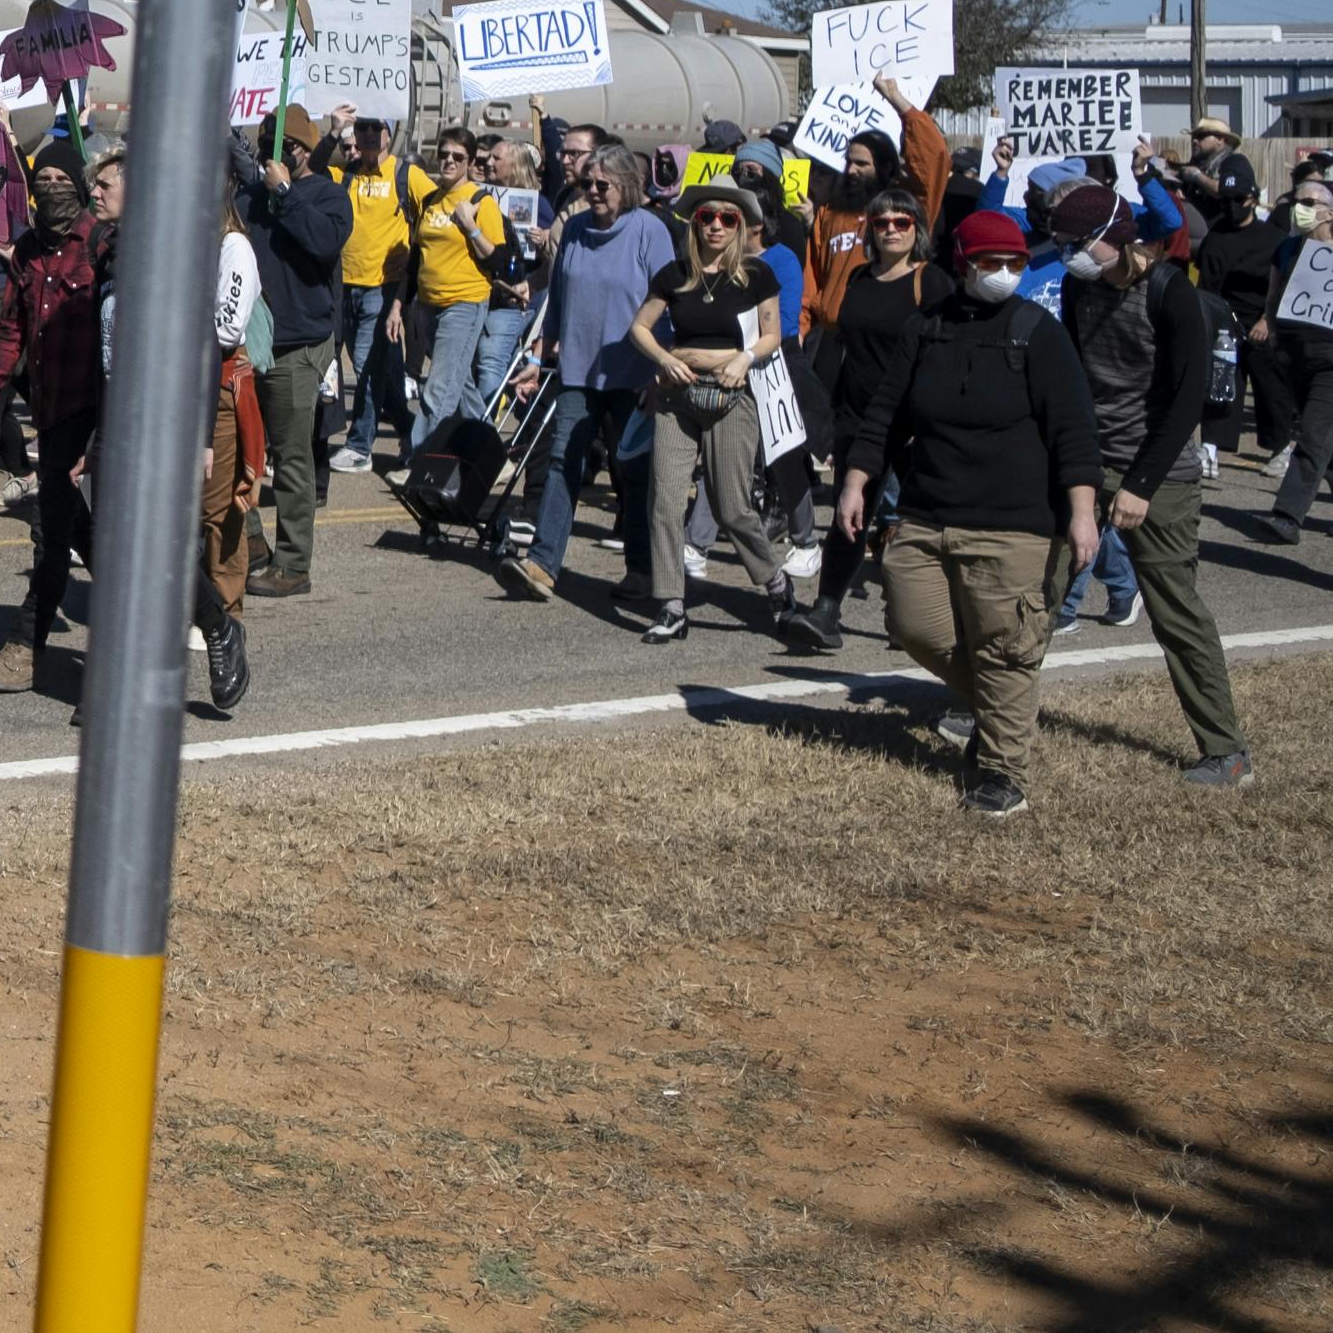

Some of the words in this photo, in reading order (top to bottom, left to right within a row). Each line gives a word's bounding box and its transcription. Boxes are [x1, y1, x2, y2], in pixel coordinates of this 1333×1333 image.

[15, 22, 93, 59] FAMILIA
[312, 30, 408, 57] TRUMP'S
[459, 1, 601, 62] LIBERTAD!
[826, 3, 929, 48] FUCK
[236, 39, 269, 63] WE
[853, 36, 921, 76] ICE
[307, 64, 408, 91] GESTAPO
[1008, 72, 1132, 103] REMEMBER
[822, 85, 886, 132] LOVE
